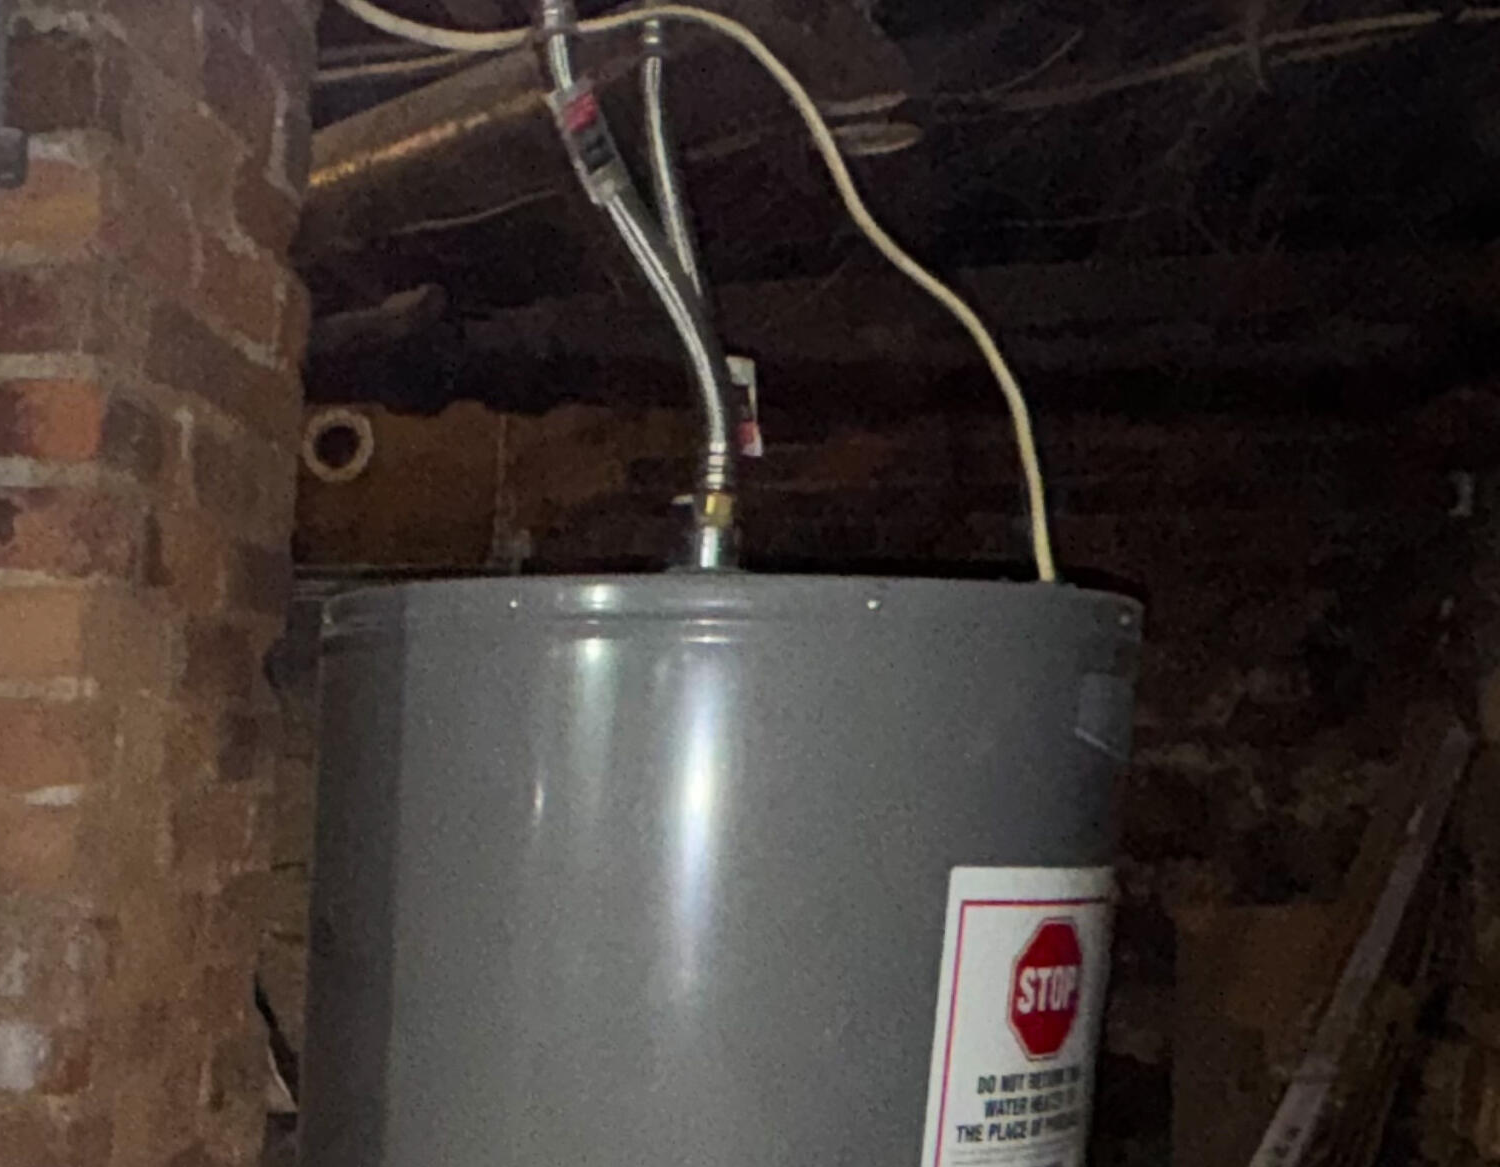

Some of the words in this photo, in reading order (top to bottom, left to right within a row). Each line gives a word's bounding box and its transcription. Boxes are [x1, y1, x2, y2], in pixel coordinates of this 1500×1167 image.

[1017, 965, 1077, 1014] STOP
[977, 1074, 996, 1094] DO
[1002, 1073, 1025, 1093] NOT
[984, 1096, 1029, 1118] WATER
[956, 1124, 984, 1143] THE
[988, 1121, 1028, 1142] PLACE
